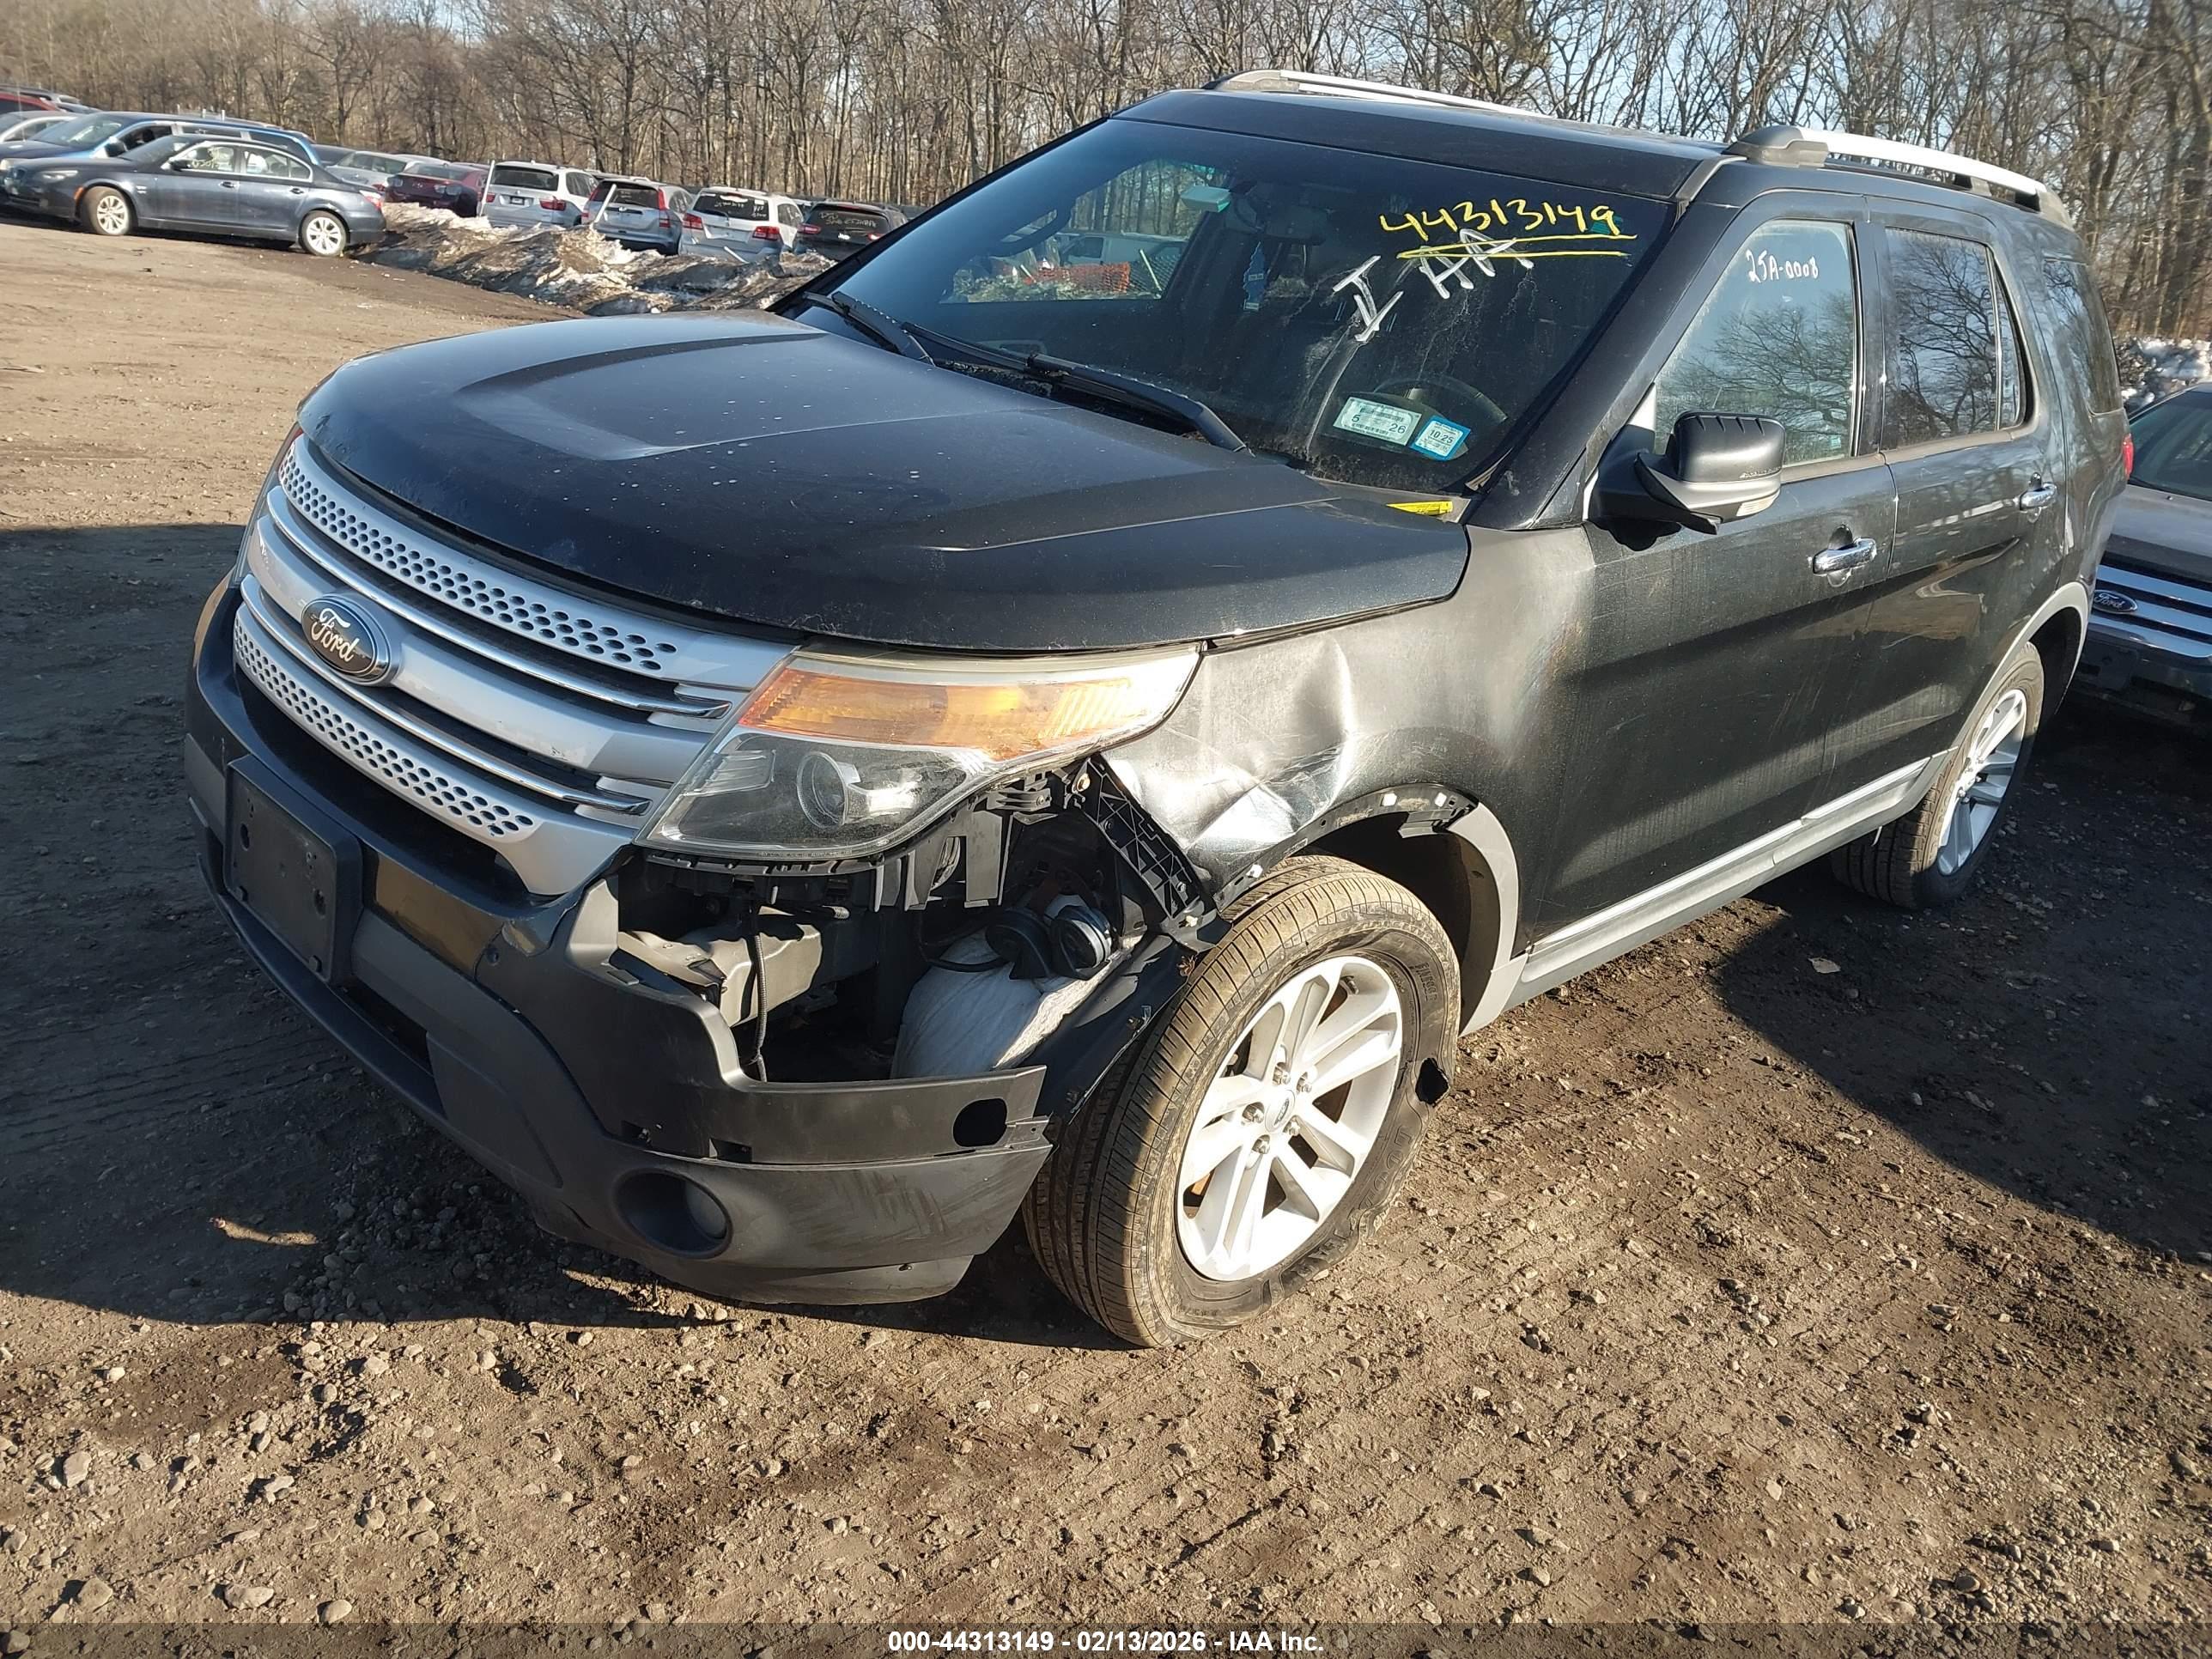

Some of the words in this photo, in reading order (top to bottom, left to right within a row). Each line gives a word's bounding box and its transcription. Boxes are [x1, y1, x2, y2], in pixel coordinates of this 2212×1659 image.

[1379, 198, 1620, 241] 44313149
[1745, 249, 1819, 283] 25A-0008
[1389, 422, 1407, 434] 26
[2094, 592, 2126, 609] Ford
[310, 607, 361, 663] Ford
